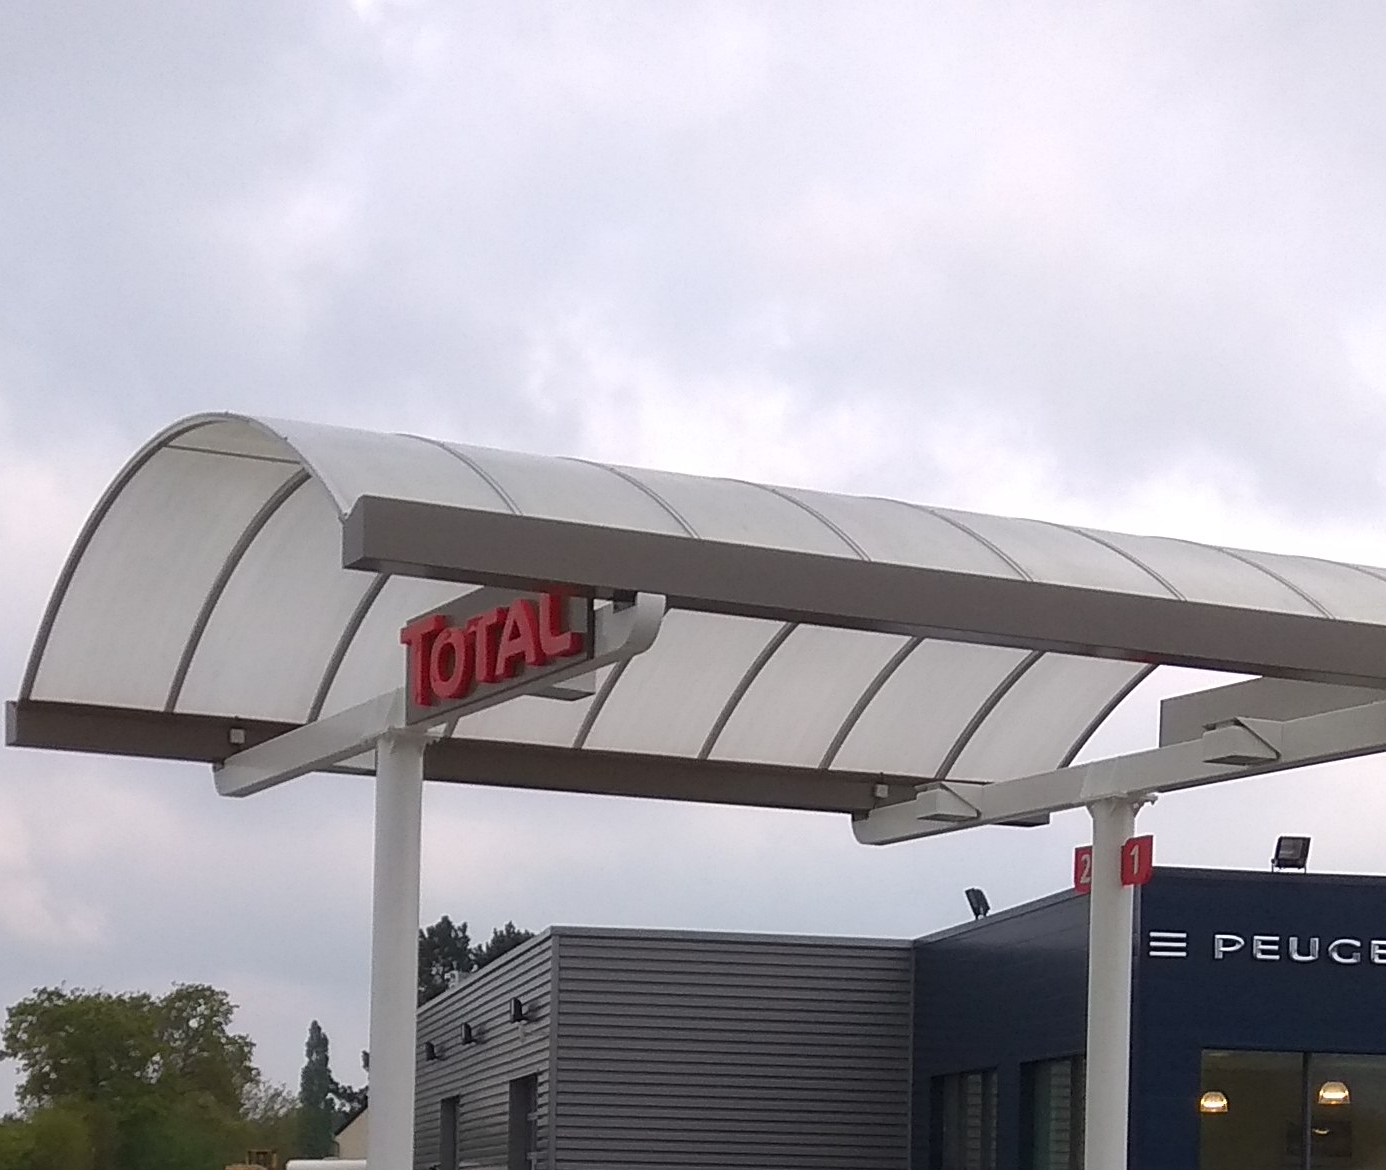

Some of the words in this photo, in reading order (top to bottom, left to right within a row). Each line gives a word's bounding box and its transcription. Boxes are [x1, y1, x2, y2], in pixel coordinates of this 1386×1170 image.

[400, 587, 583, 706] TOTAL
[1080, 853, 1091, 884] 2
[1130, 844, 1140, 875] 1
